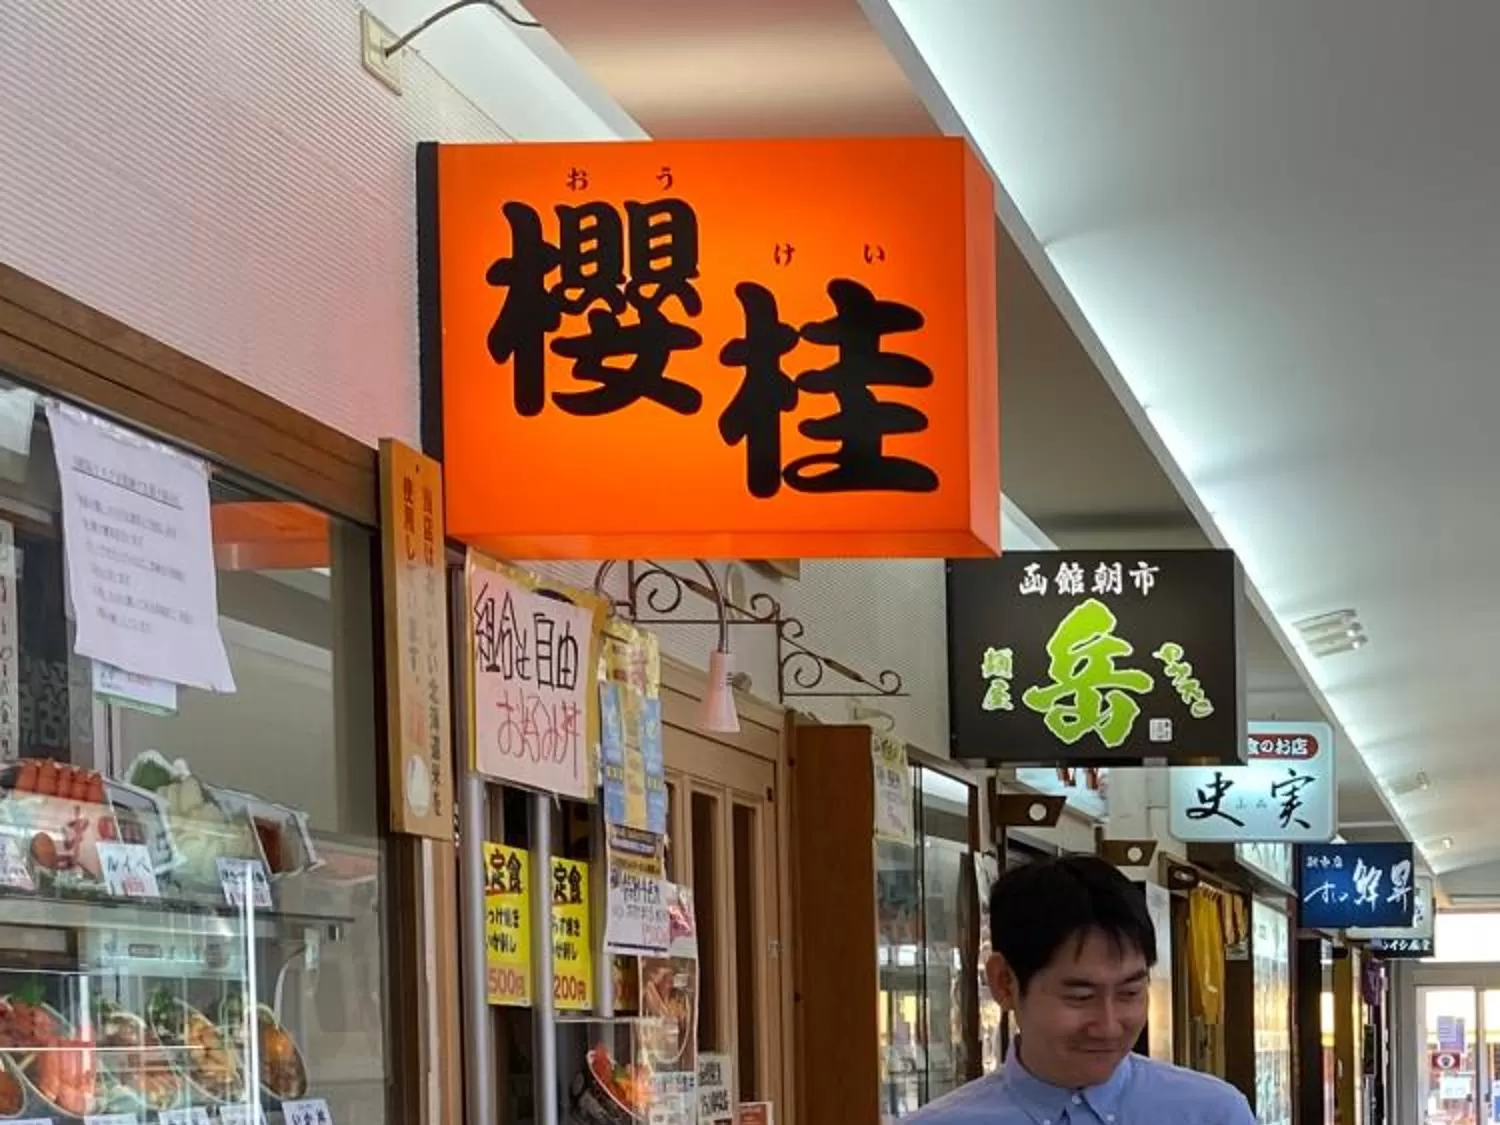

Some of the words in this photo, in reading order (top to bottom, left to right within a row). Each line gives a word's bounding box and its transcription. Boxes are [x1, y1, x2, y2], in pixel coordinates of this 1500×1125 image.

[485, 198, 939, 499] 櫻桂
[474, 582, 580, 690] 組合せ自由
[1019, 561, 1160, 596] 函館朝市
[1022, 598, 1154, 748] 岳
